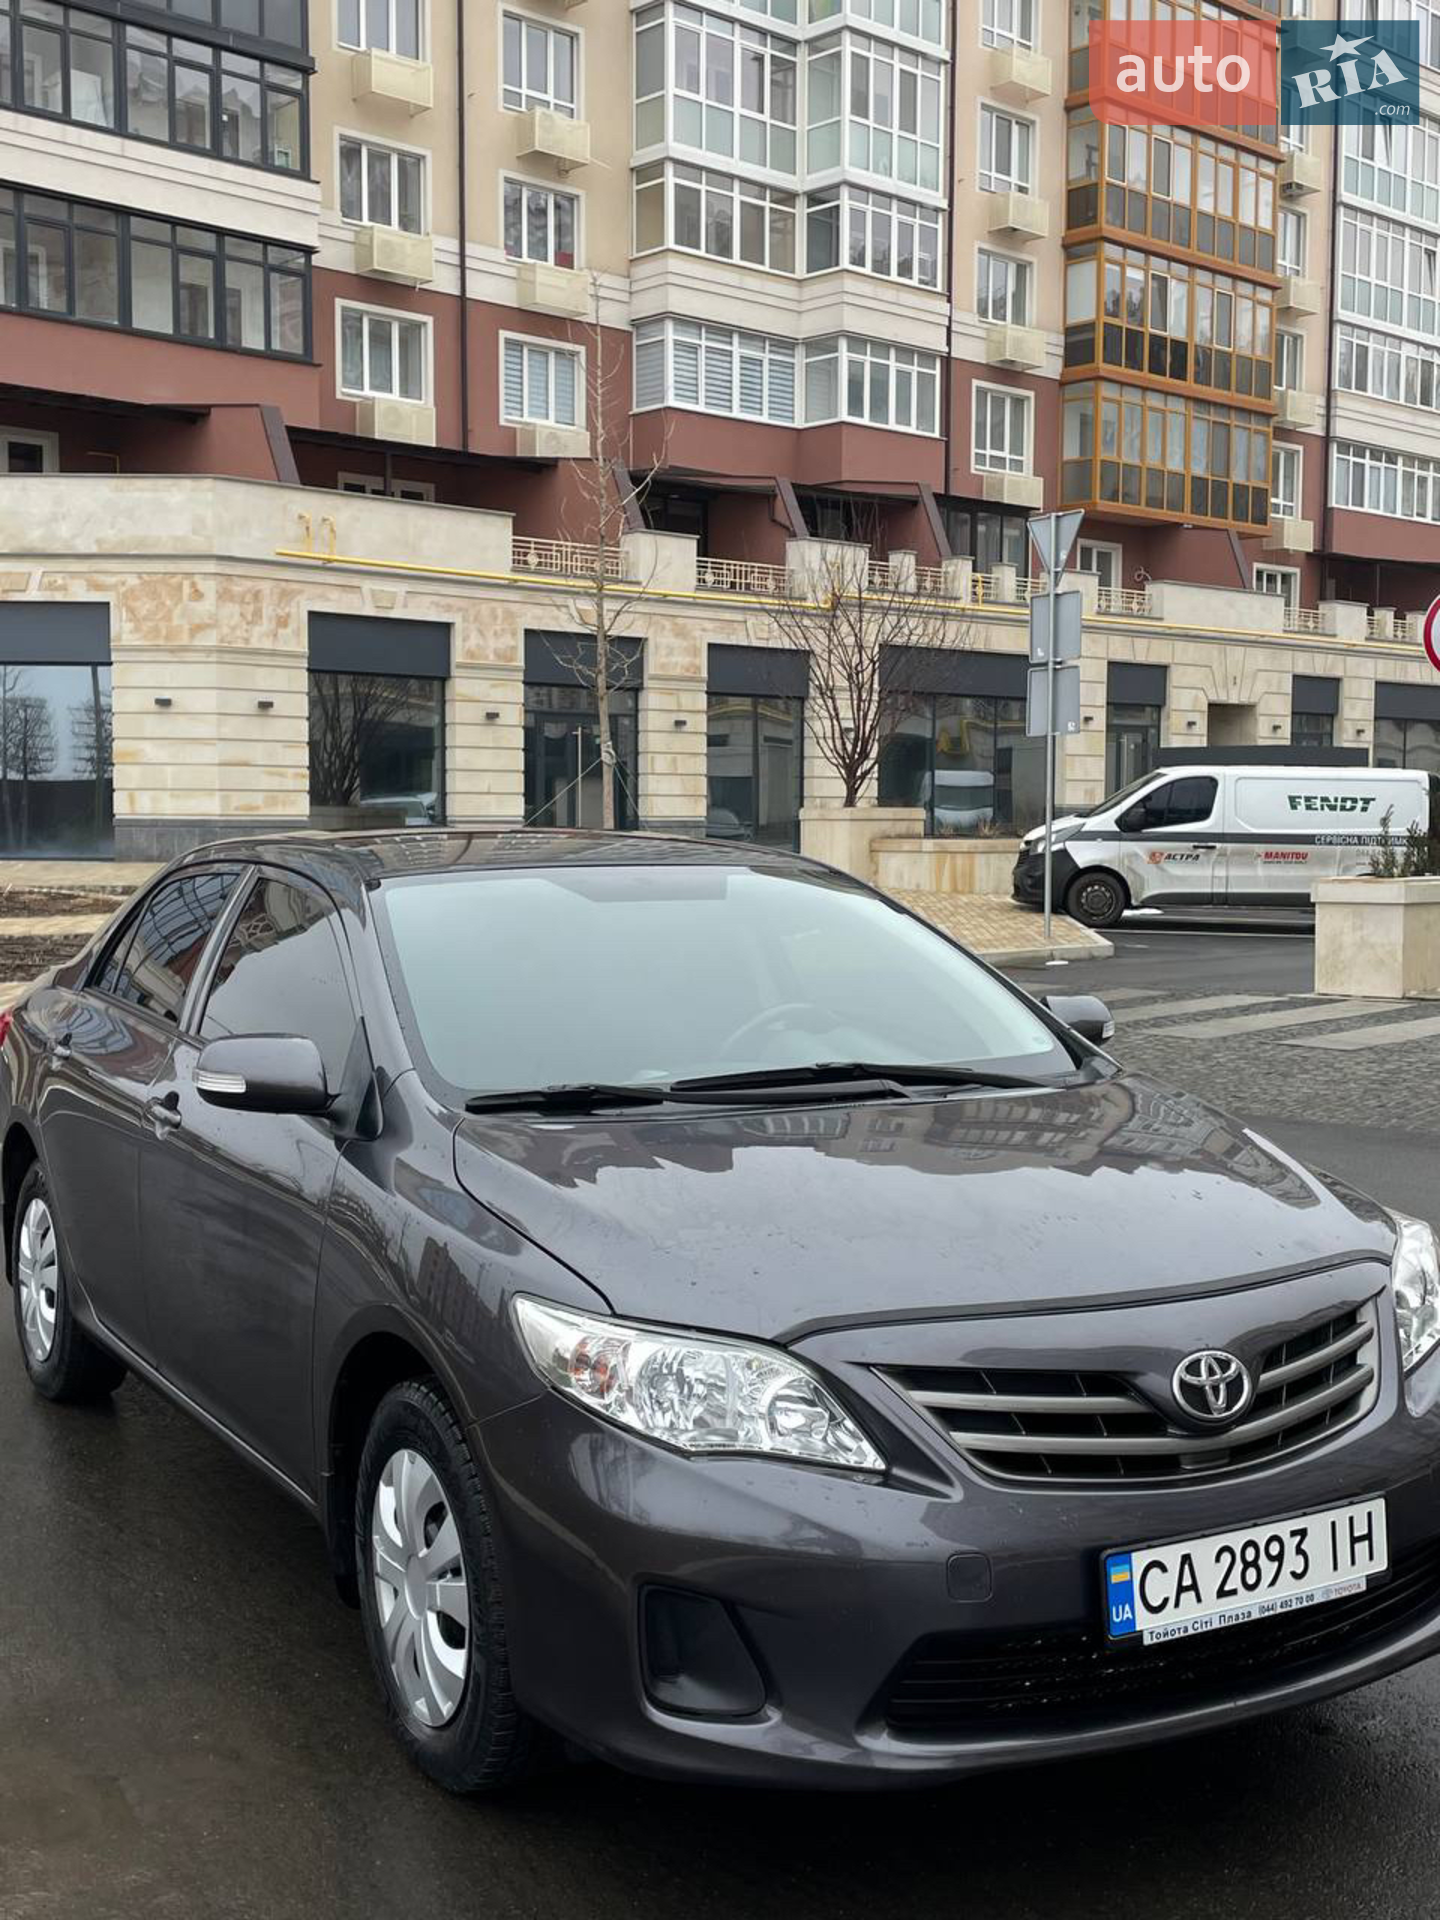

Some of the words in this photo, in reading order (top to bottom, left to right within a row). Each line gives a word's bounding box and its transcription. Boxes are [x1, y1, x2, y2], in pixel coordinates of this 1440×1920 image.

[1287, 795, 1376, 812] FENDT
[1314, 835, 1359, 845] СЕРВІСНА
[1263, 851, 1309, 860] MANITOU
[1139, 1552, 1202, 1614] CA
[1214, 1527, 1310, 1600] 2893
[1330, 1511, 1374, 1572] IH
[1334, 1583, 1363, 1596] TOYOTA
[1112, 1606, 1133, 1623] UA
[1149, 1625, 1189, 1641] Тойота
[1191, 1617, 1213, 1632] Сіті
[1219, 1610, 1252, 1625] Плаза
[1258, 1602, 1277, 1615] (044)
